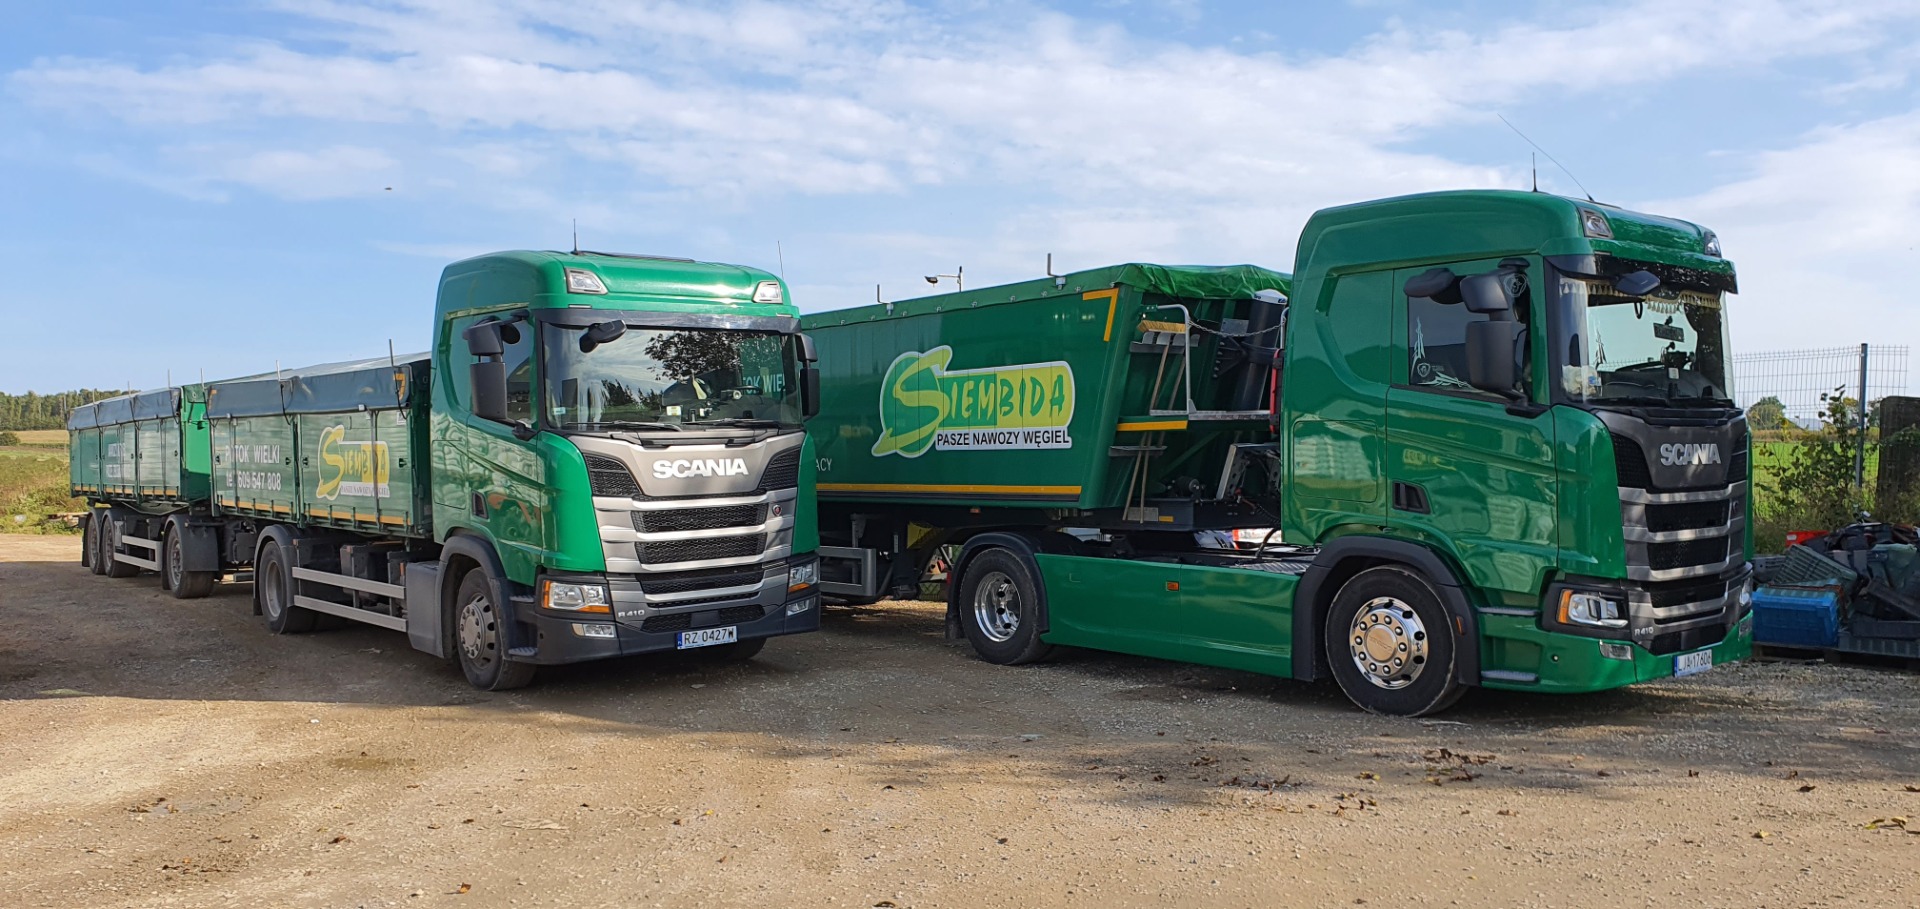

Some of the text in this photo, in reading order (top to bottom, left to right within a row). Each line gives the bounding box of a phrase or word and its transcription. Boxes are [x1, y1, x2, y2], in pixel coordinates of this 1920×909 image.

[873, 348, 1066, 455] SIEMBIDA
[937, 429, 1069, 448] PASZE NAWOZY WĘGIEL
[253, 444, 280, 464] WIELKI
[317, 426, 387, 496] SIEMBIA
[1660, 443, 1721, 466] SCANIA
[652, 458, 749, 479] SCANIA
[251, 472, 266, 490] 547
[267, 472, 282, 491] 808
[626, 609, 645, 617] 410
[684, 632, 699, 645] RZ
[1641, 625, 1654, 636] 410
